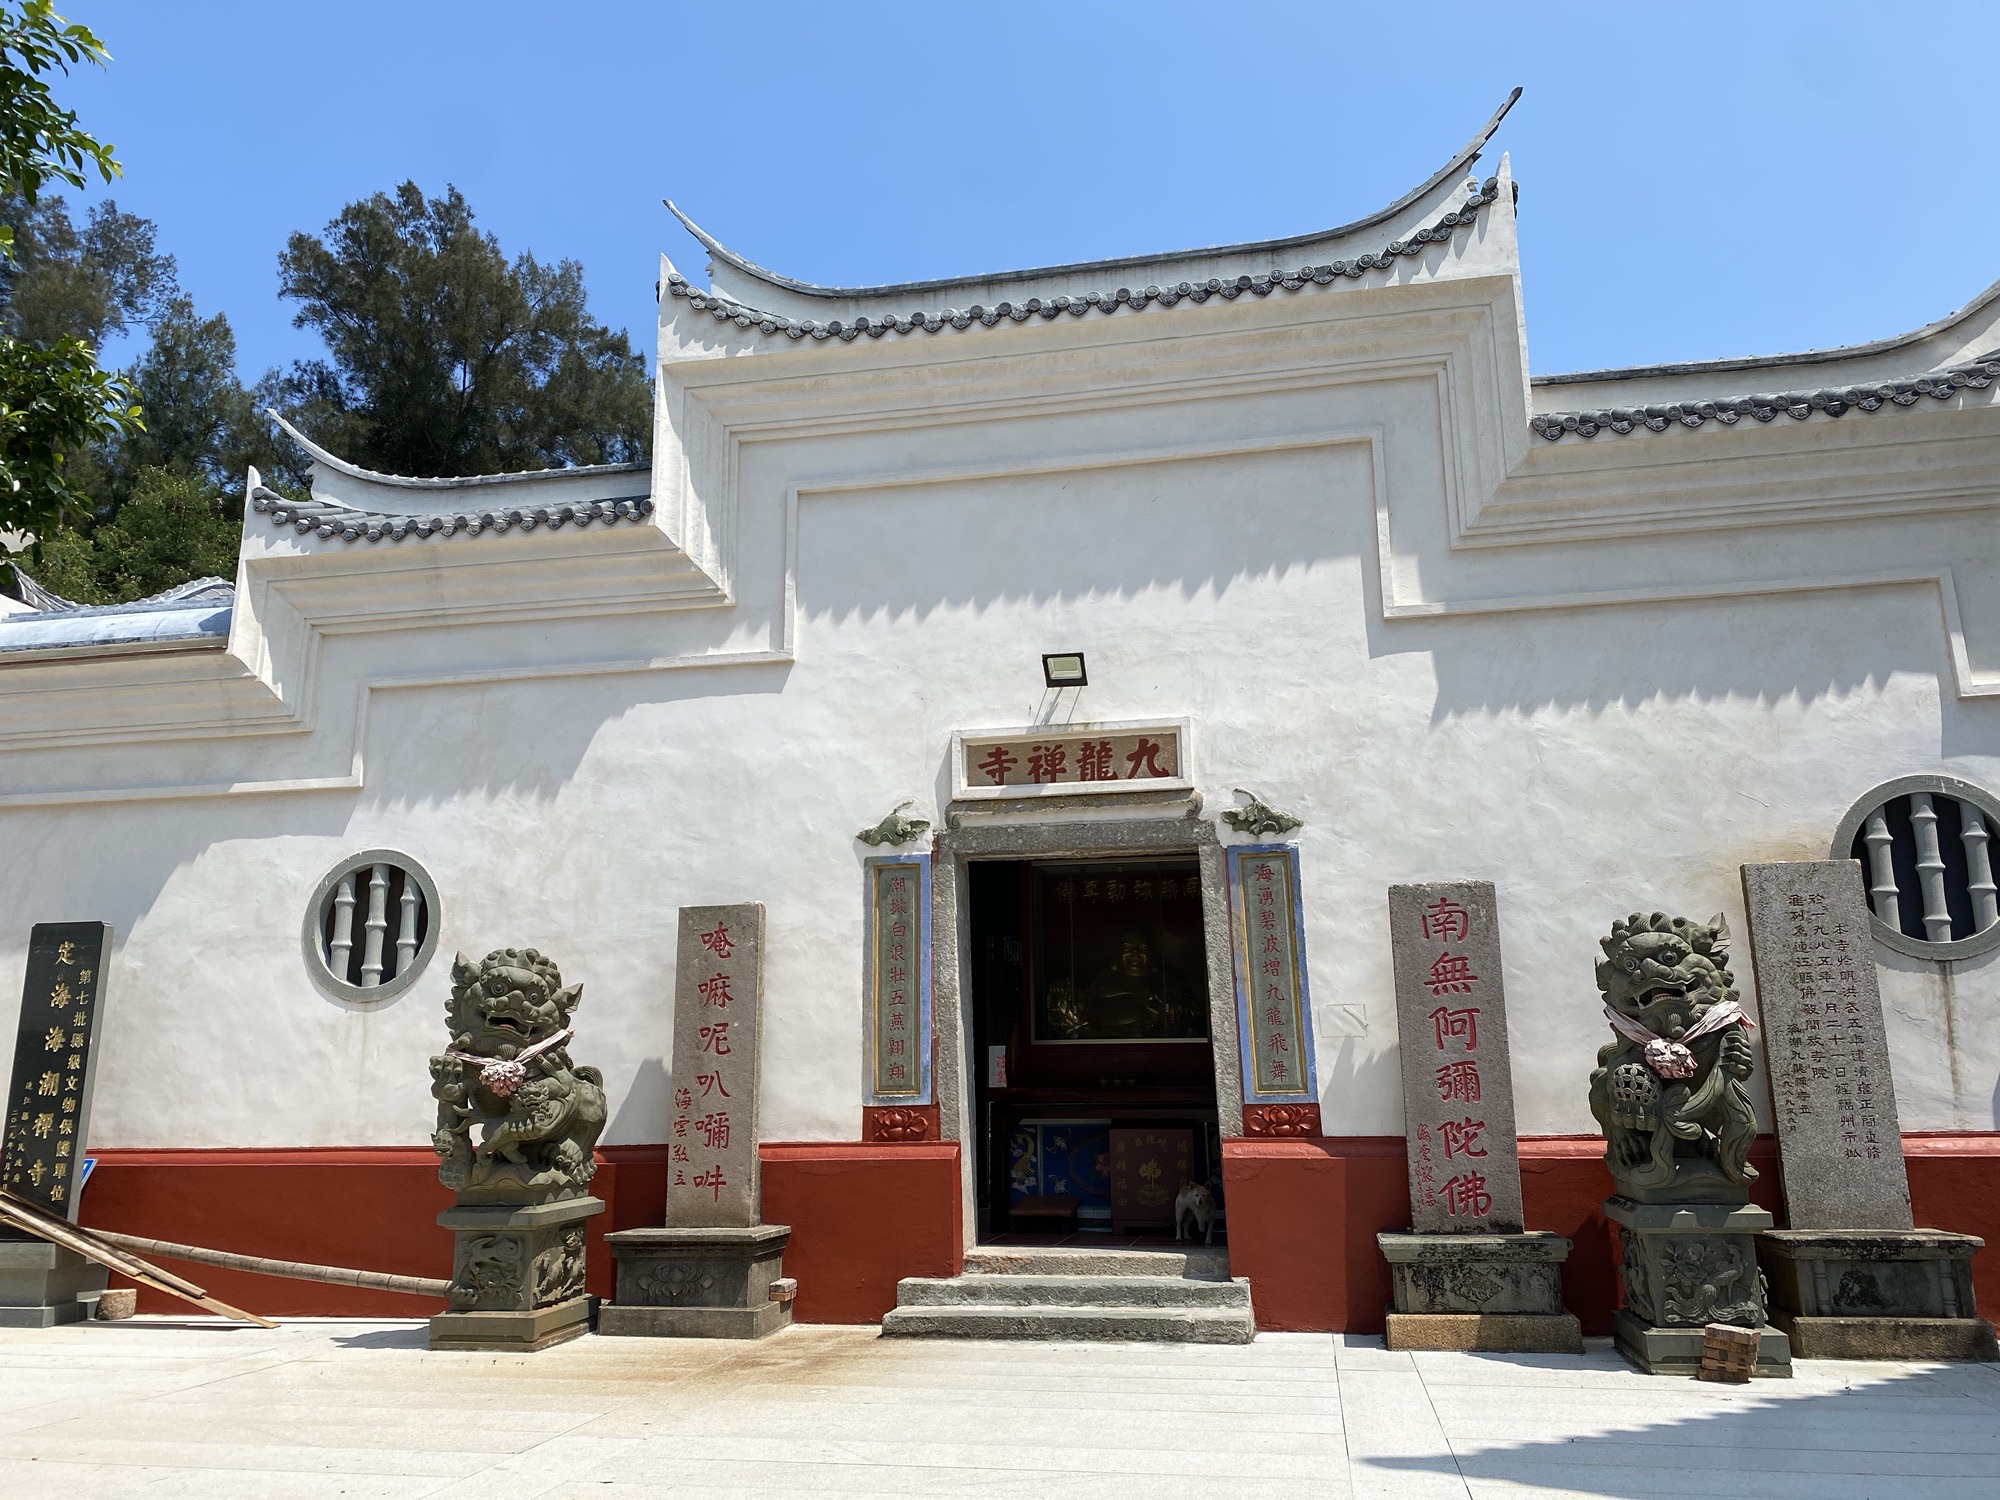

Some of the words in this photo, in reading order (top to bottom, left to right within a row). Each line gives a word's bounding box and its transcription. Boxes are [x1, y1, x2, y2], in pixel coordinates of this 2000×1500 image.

[28, 940, 76, 1187] 定海海潮禪寺
[1421, 897, 1492, 1218] 南無阿彌陀佛
